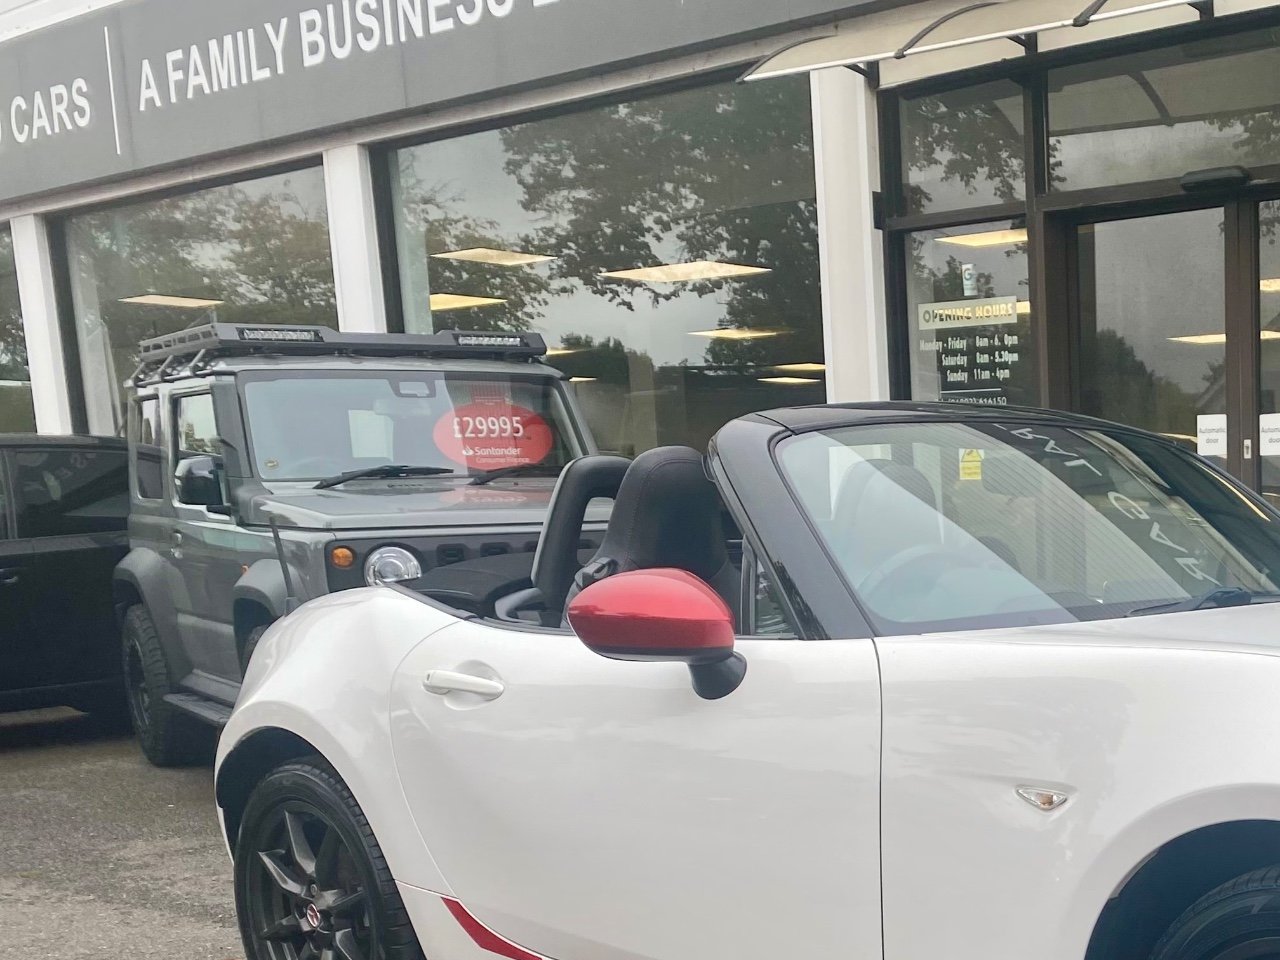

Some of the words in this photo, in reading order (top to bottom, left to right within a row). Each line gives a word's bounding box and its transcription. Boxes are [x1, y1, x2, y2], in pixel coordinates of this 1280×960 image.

[138, 58, 163, 112] A
[165, 16, 288, 104] FAMILY
[10, 77, 91, 144] CARS
[923, 307, 972, 324] OPENING
[975, 302, 1014, 320] HOURS
[948, 336, 967, 351] Friday
[942, 353, 967, 367] Saturday
[947, 369, 968, 383] Sunday
[453, 416, 524, 438] £29995
[474, 446, 521, 456] Santander
